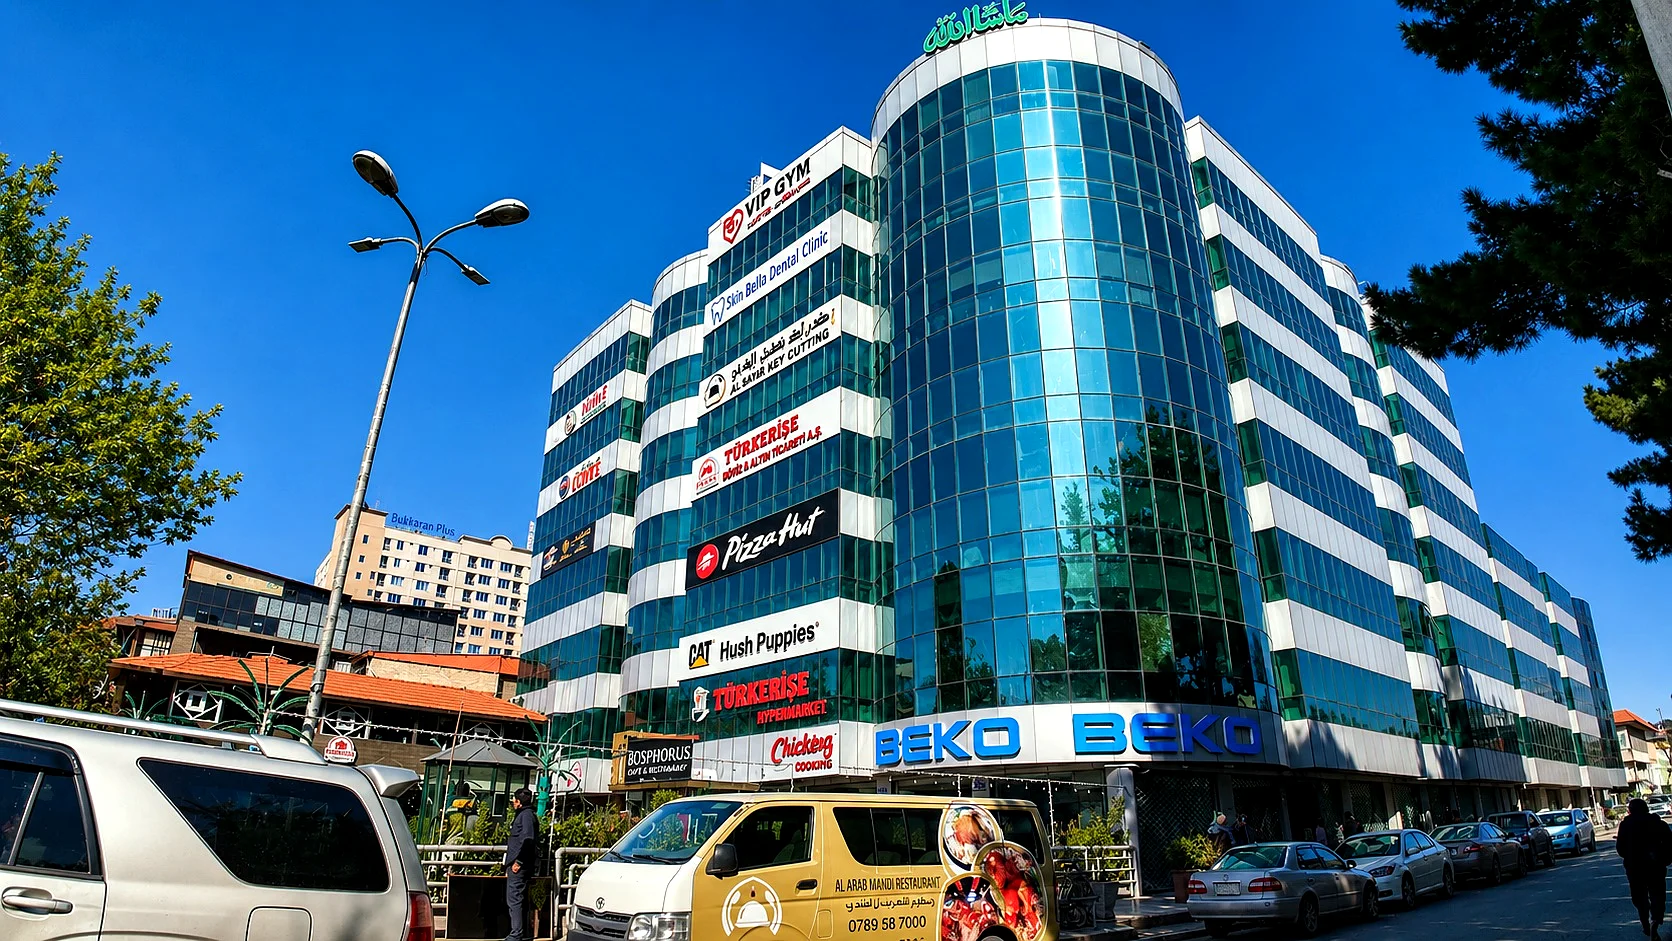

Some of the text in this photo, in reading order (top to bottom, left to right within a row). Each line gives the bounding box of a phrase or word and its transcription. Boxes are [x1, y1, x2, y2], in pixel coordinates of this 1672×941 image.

[745, 188, 771, 218] VIP
[774, 157, 811, 197] GYM
[726, 230, 829, 310] Skin Bella Dental Clinic
[730, 382, 741, 396] AL
[767, 353, 785, 374] KEY
[787, 327, 830, 361] CUTTING
[724, 414, 799, 466] TÜRKERİŞE
[391, 512, 456, 537] Bukkaran Plus
[722, 506, 826, 571] Pizza Hut
[689, 624, 816, 668] CAT Hush Puppies
[713, 669, 810, 711] TÜRKERİŞE
[757, 698, 828, 725] HYPERMARKET
[627, 745, 691, 766] BOSPHORUS
[875, 712, 1262, 768] BEKO BEKO
[795, 758, 833, 773] COOKING
[835, 876, 941, 893] AL ARAB MANDI RESTAURANT
[848, 915, 927, 933] 0789 58 7000
